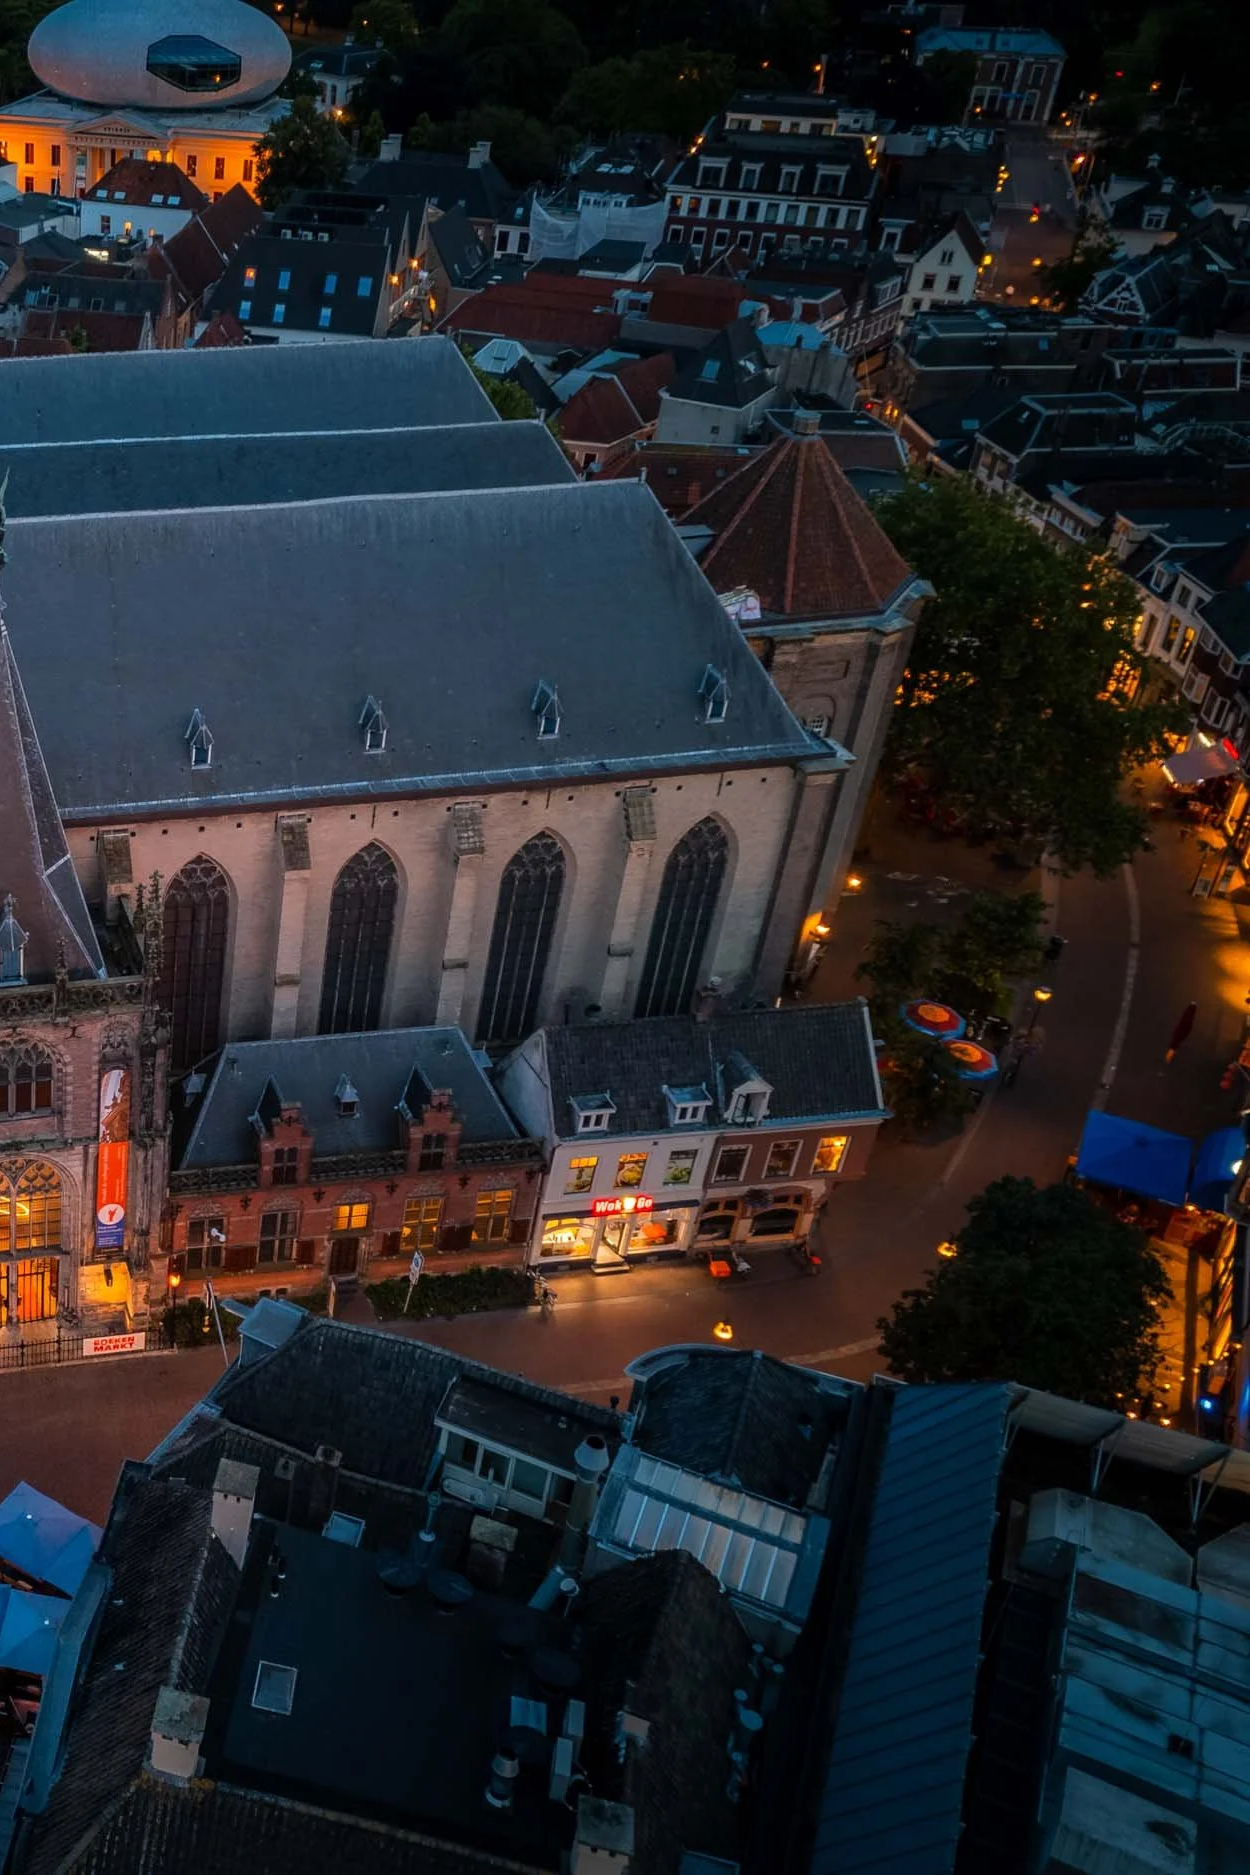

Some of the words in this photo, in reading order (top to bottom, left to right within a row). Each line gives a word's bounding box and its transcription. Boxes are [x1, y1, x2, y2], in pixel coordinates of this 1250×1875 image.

[595, 1199, 623, 1213] Wok
[636, 1196, 653, 1209] Go
[94, 1336, 135, 1346] BOEKEN
[94, 1343, 134, 1352] MARKT
